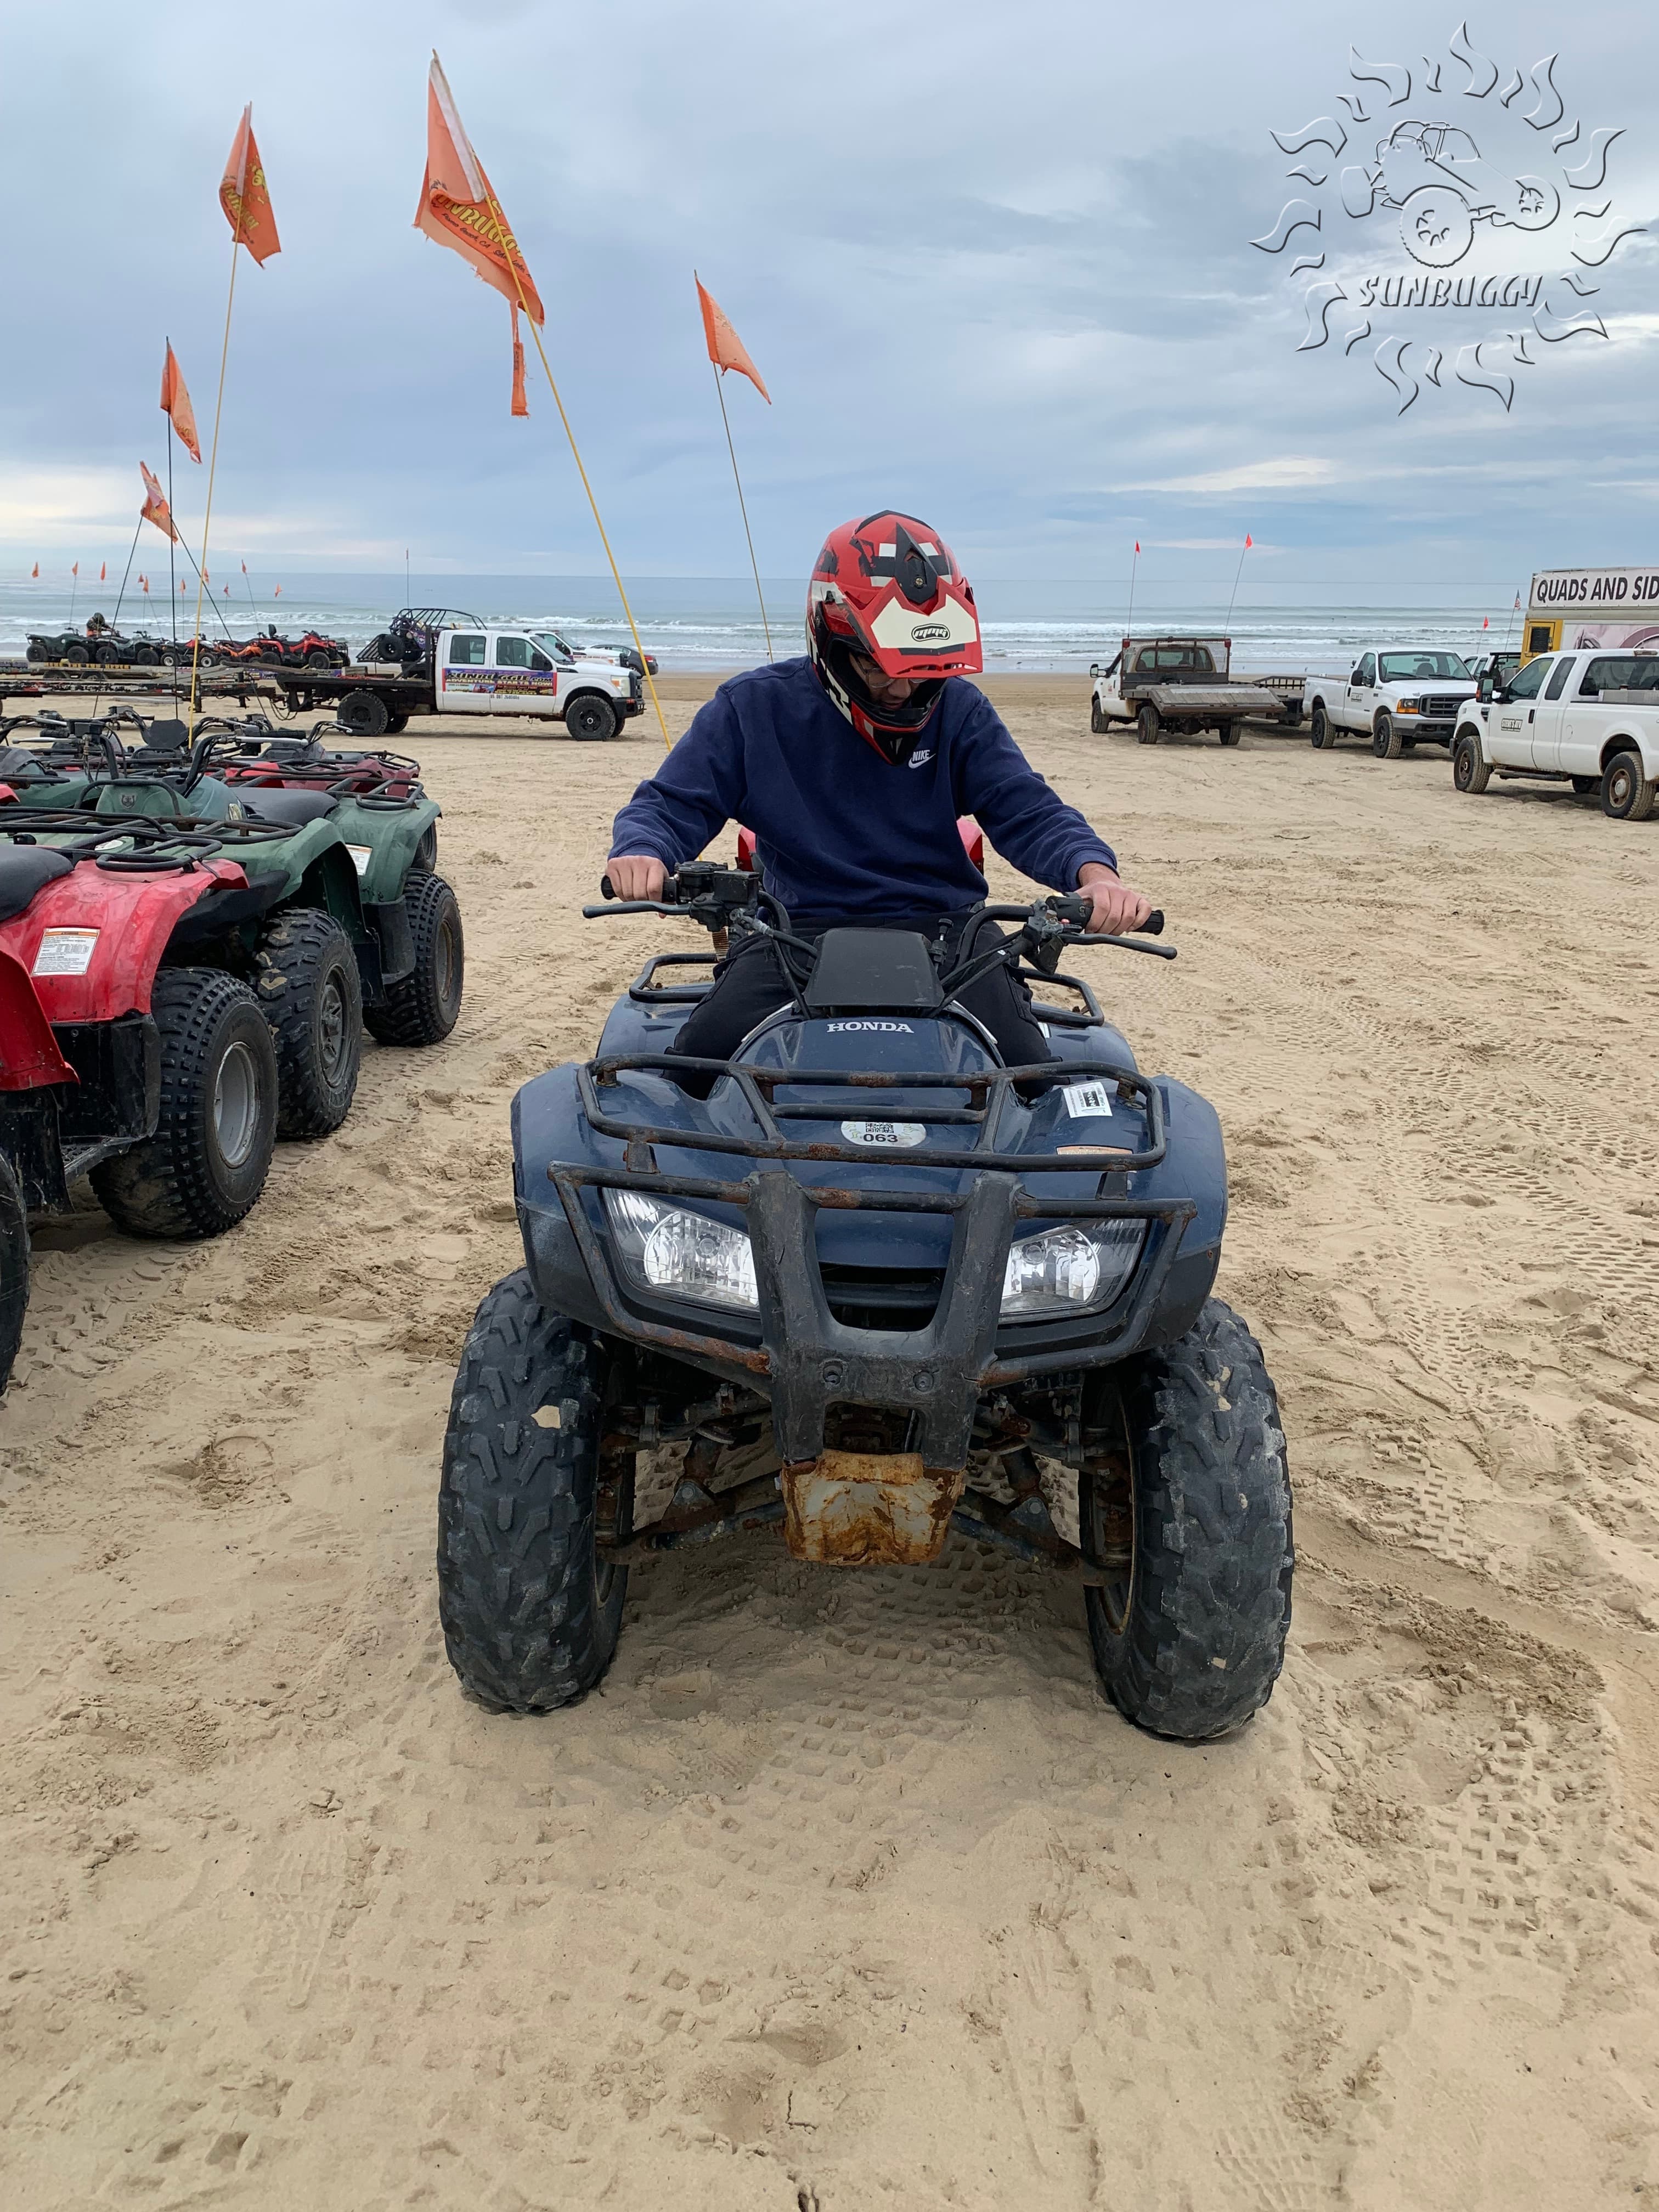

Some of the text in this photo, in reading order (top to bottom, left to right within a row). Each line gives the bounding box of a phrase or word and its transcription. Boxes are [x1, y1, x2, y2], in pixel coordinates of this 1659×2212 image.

[1537, 575, 1659, 603] QUADS AND SID
[912, 749, 930, 762] NIKE
[827, 1022, 915, 1034] HONDA
[863, 1133, 899, 1143] 063
